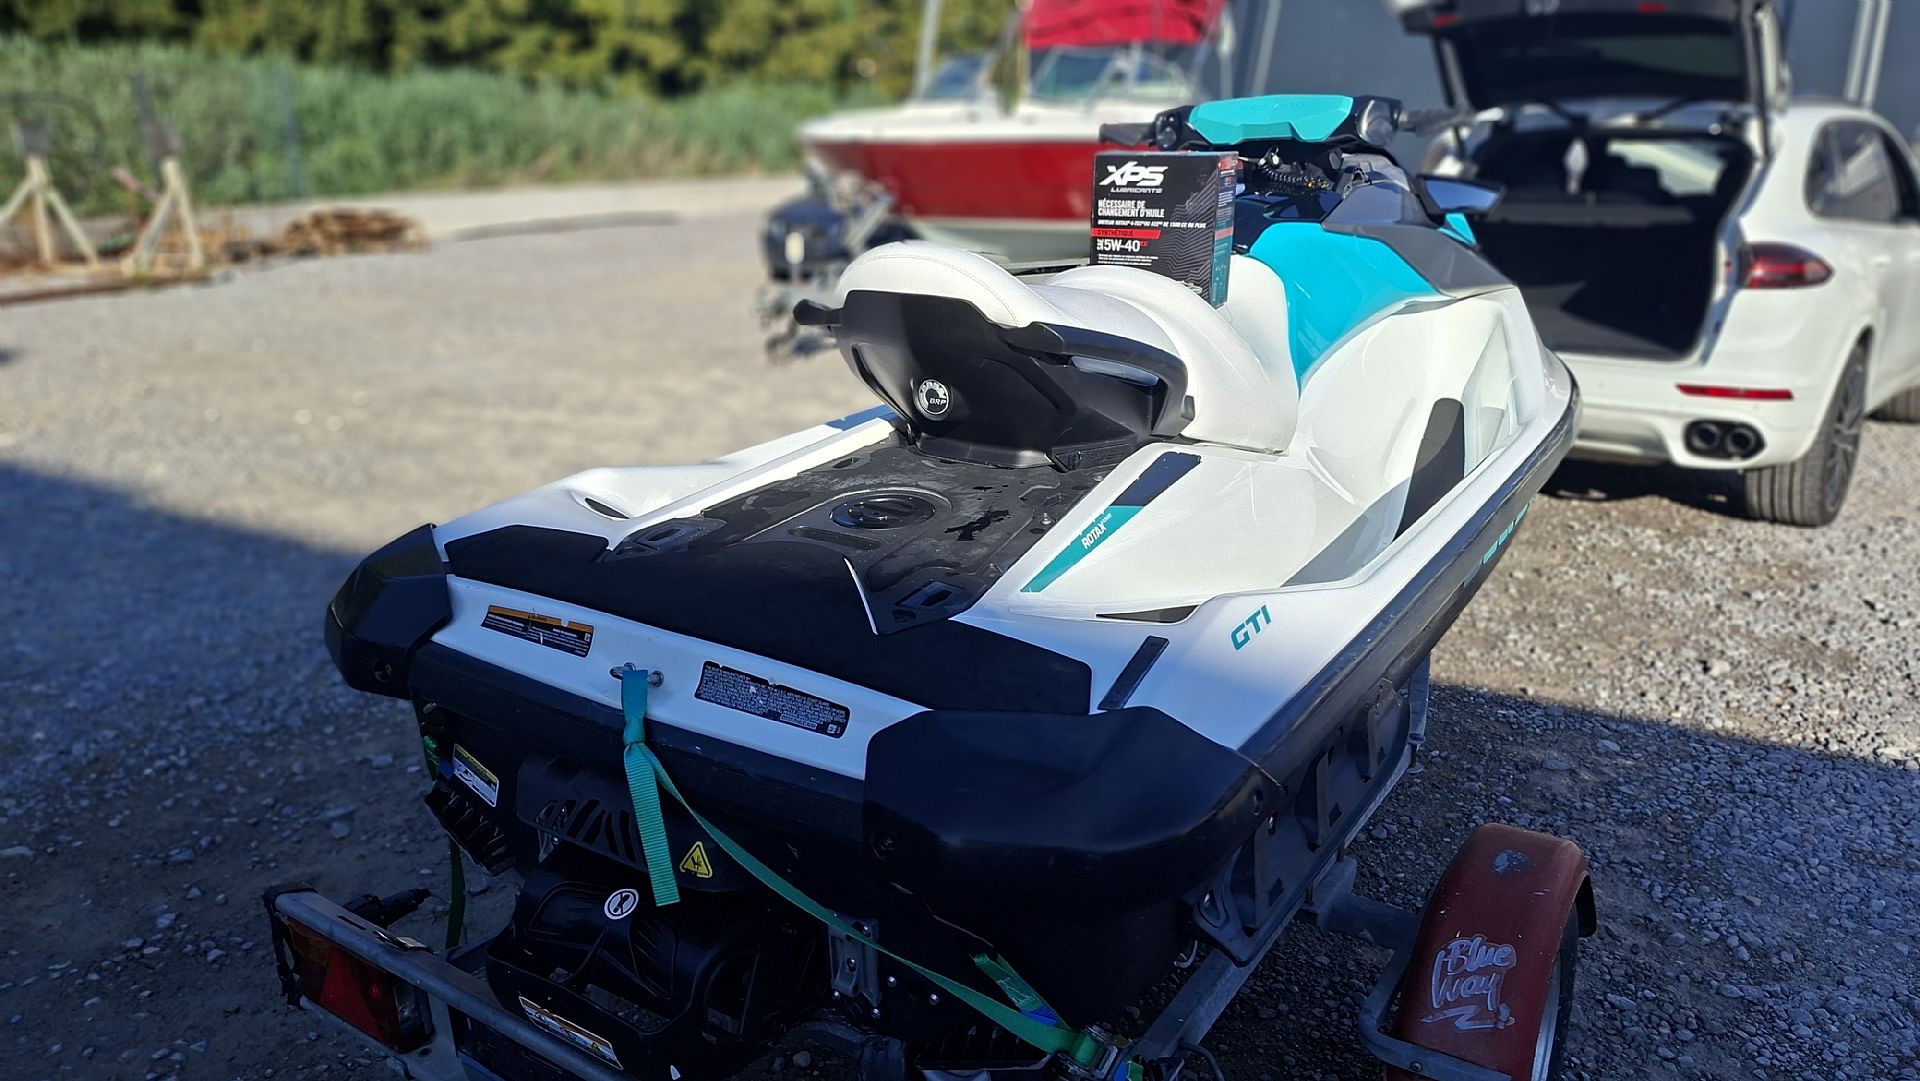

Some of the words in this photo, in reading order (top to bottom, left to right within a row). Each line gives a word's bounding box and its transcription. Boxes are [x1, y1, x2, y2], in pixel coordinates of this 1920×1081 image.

[1099, 161, 1168, 186] XPS
[1098, 198, 1136, 208] NÉCESSAIRE
[1137, 200, 1146, 209] DE
[1098, 208, 1138, 217] CHANGEMENT
[1140, 209, 1165, 218] D'HUILE
[1104, 239, 1140, 252] 5W-40
[1081, 521, 1106, 549] ROTAX
[1231, 604, 1271, 650] GTI
[1443, 936, 1513, 975] Blue
